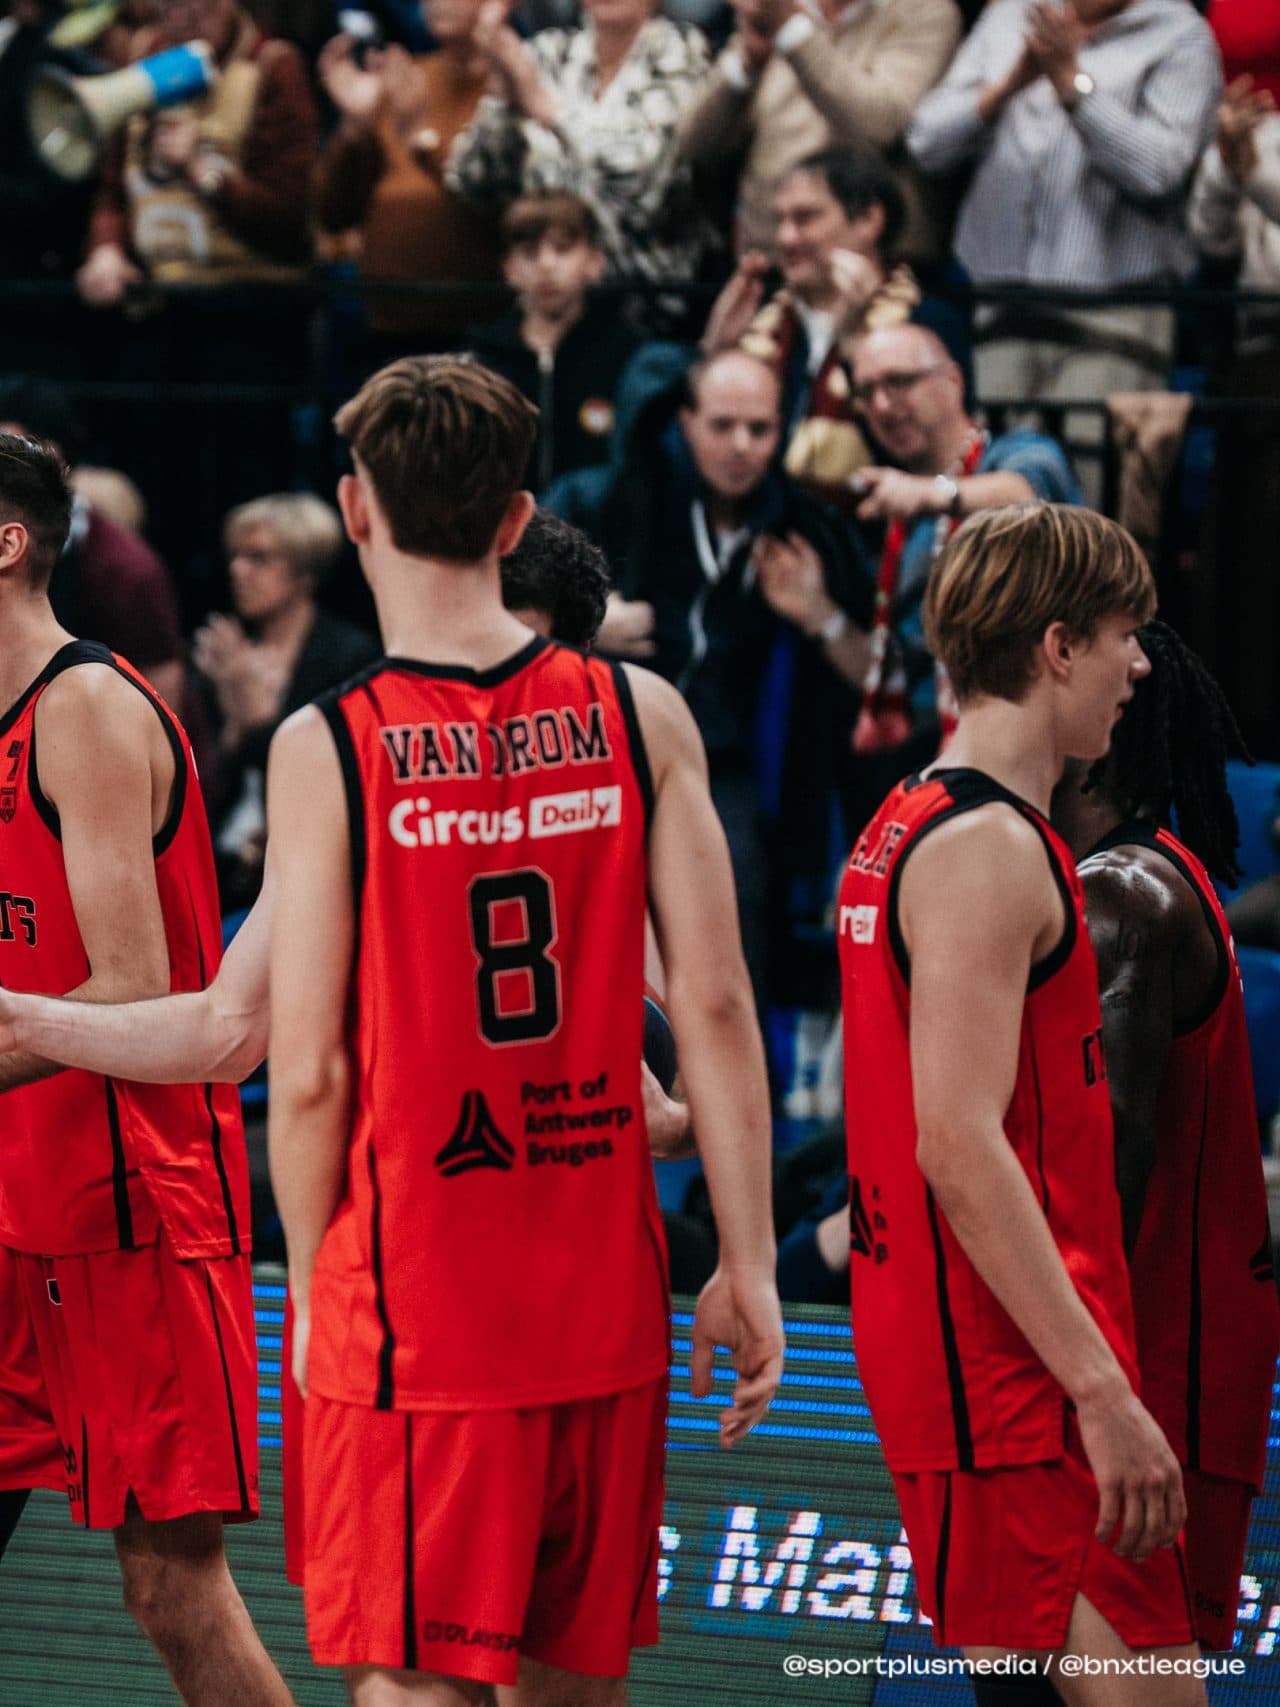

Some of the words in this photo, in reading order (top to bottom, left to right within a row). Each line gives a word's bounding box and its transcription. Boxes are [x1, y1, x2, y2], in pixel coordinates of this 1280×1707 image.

[380, 722, 482, 785] VAN
[388, 796, 524, 848] Circus
[541, 798, 612, 829] Daily
[467, 866, 562, 1049] 8
[521, 1081, 571, 1104] Port
[580, 1071, 608, 1099] of
[525, 1105, 633, 1136] Antwerp
[527, 1138, 613, 1167] Bruges
[707, 1505, 934, 1627] Mat
